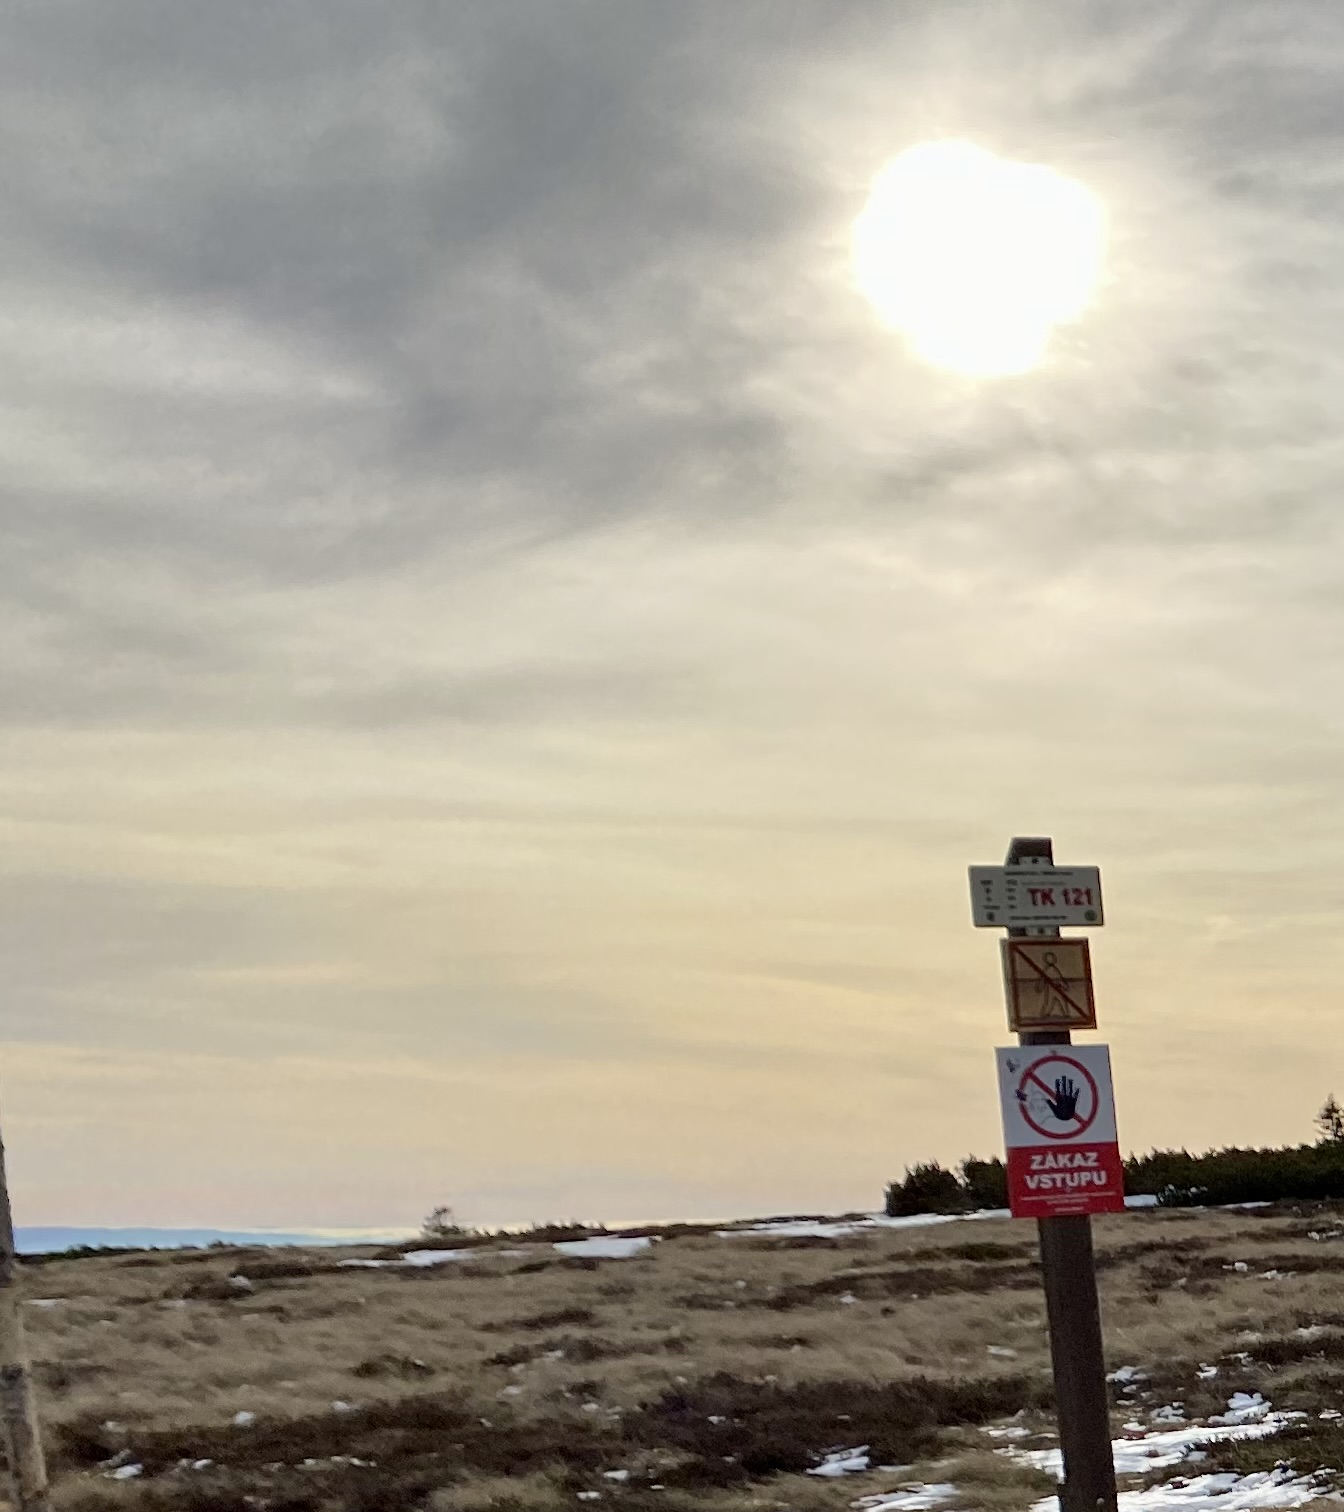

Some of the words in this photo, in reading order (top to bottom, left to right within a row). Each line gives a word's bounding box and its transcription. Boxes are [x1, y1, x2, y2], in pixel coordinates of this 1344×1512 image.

[1028, 888, 1055, 906] TK
[1062, 887, 1093, 906] 121
[1030, 1150, 1099, 1170] ZÁKAZ
[1024, 1170, 1107, 1190] VSTUPU
